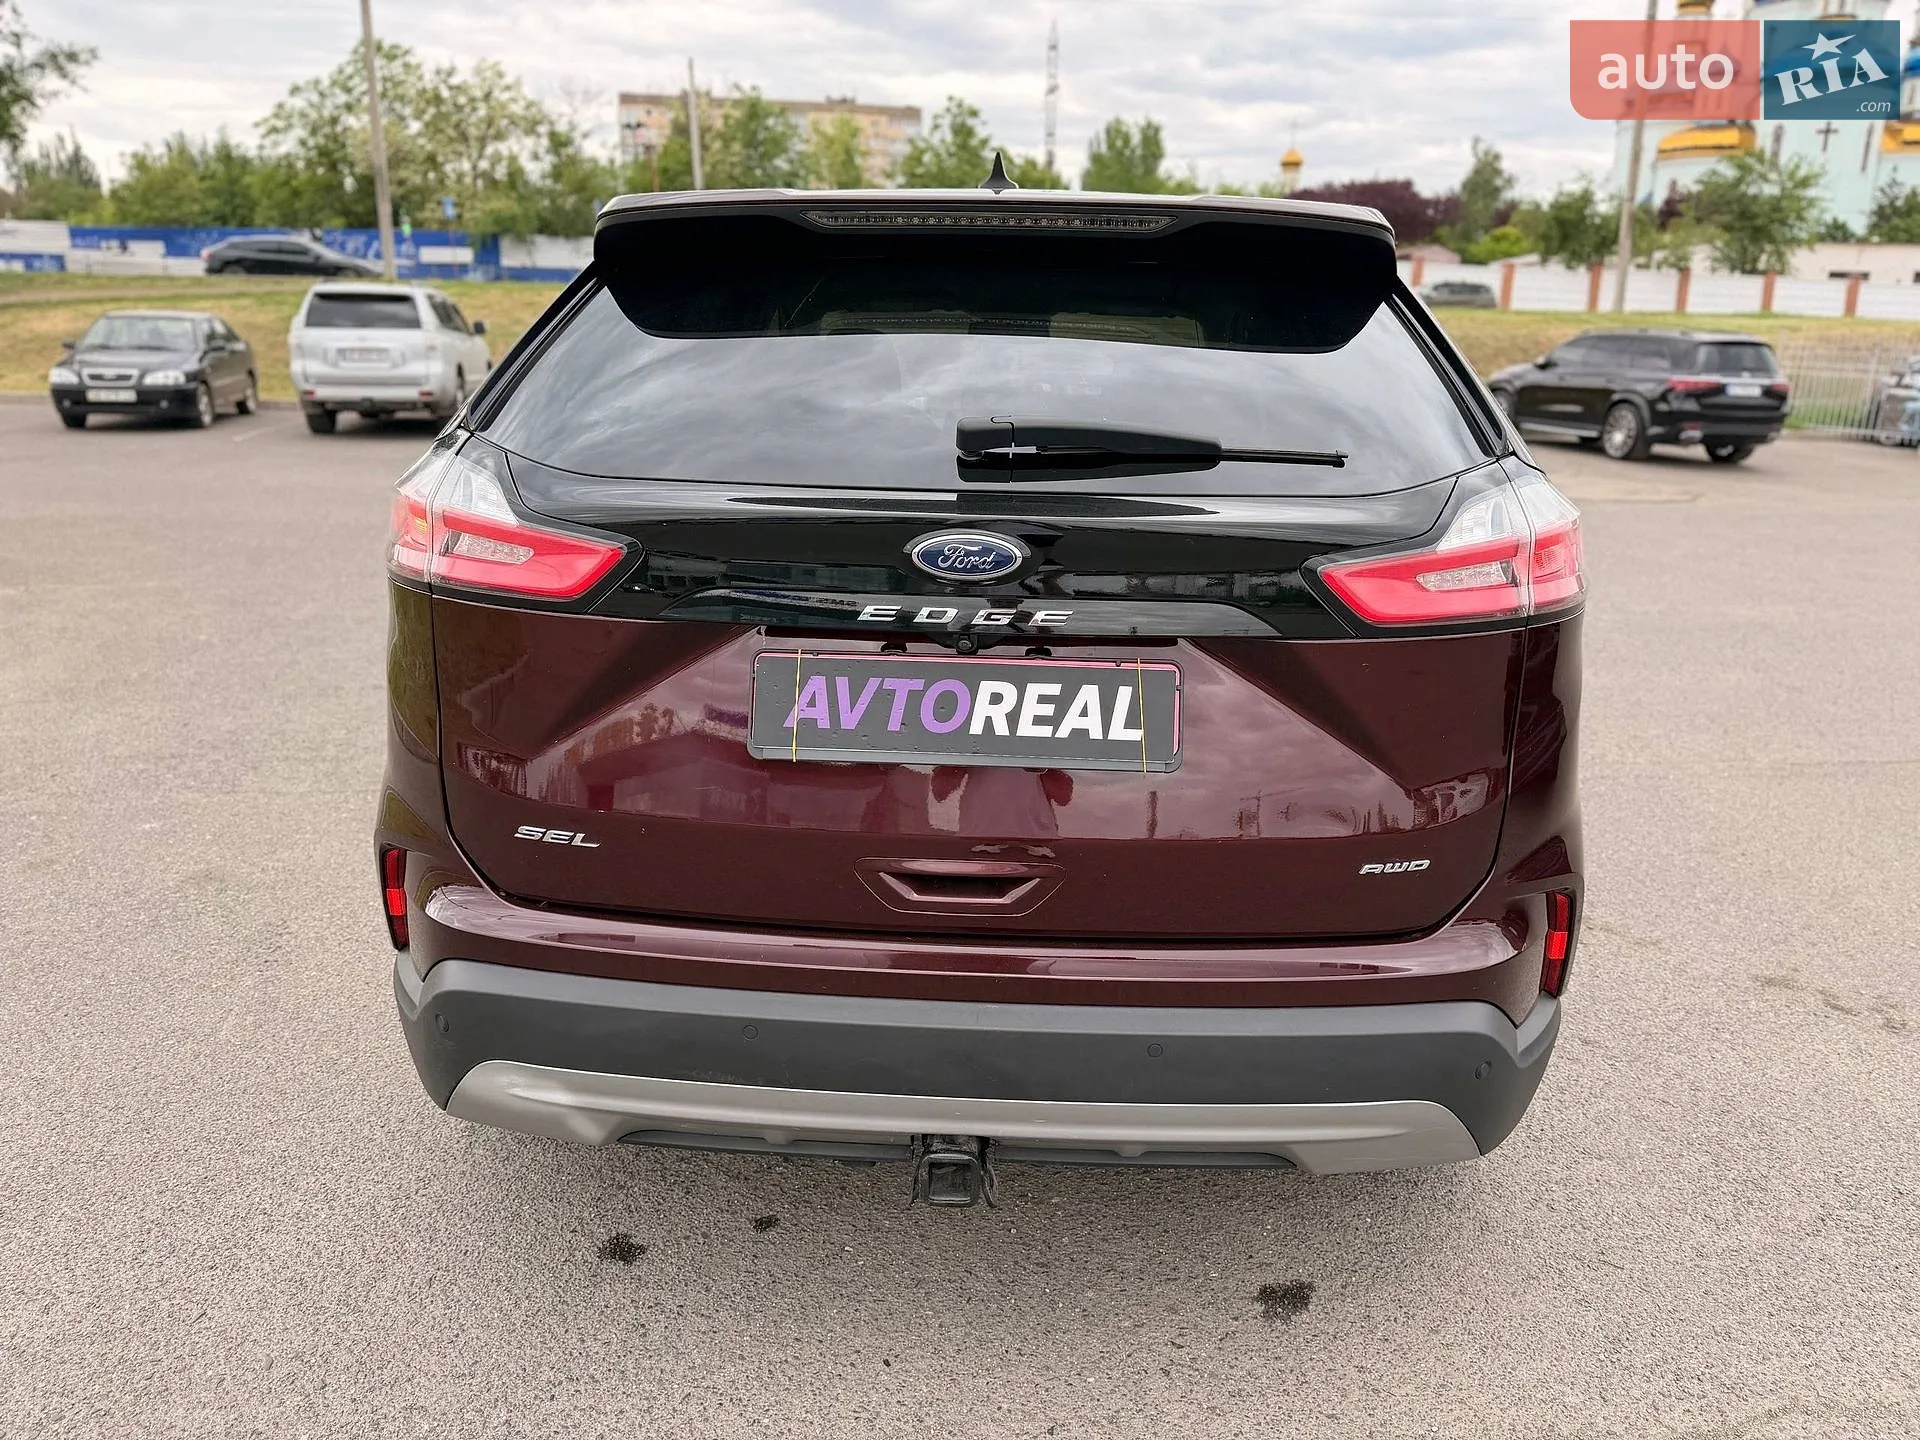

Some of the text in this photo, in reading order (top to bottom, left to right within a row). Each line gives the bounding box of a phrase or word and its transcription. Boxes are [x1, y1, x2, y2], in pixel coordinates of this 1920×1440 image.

[937, 543, 997, 570] Ford
[857, 605, 1074, 627] EDGE
[783, 674, 1144, 742] AVTOREAL
[514, 825, 601, 848] SEL
[1359, 859, 1431, 875] AWD
